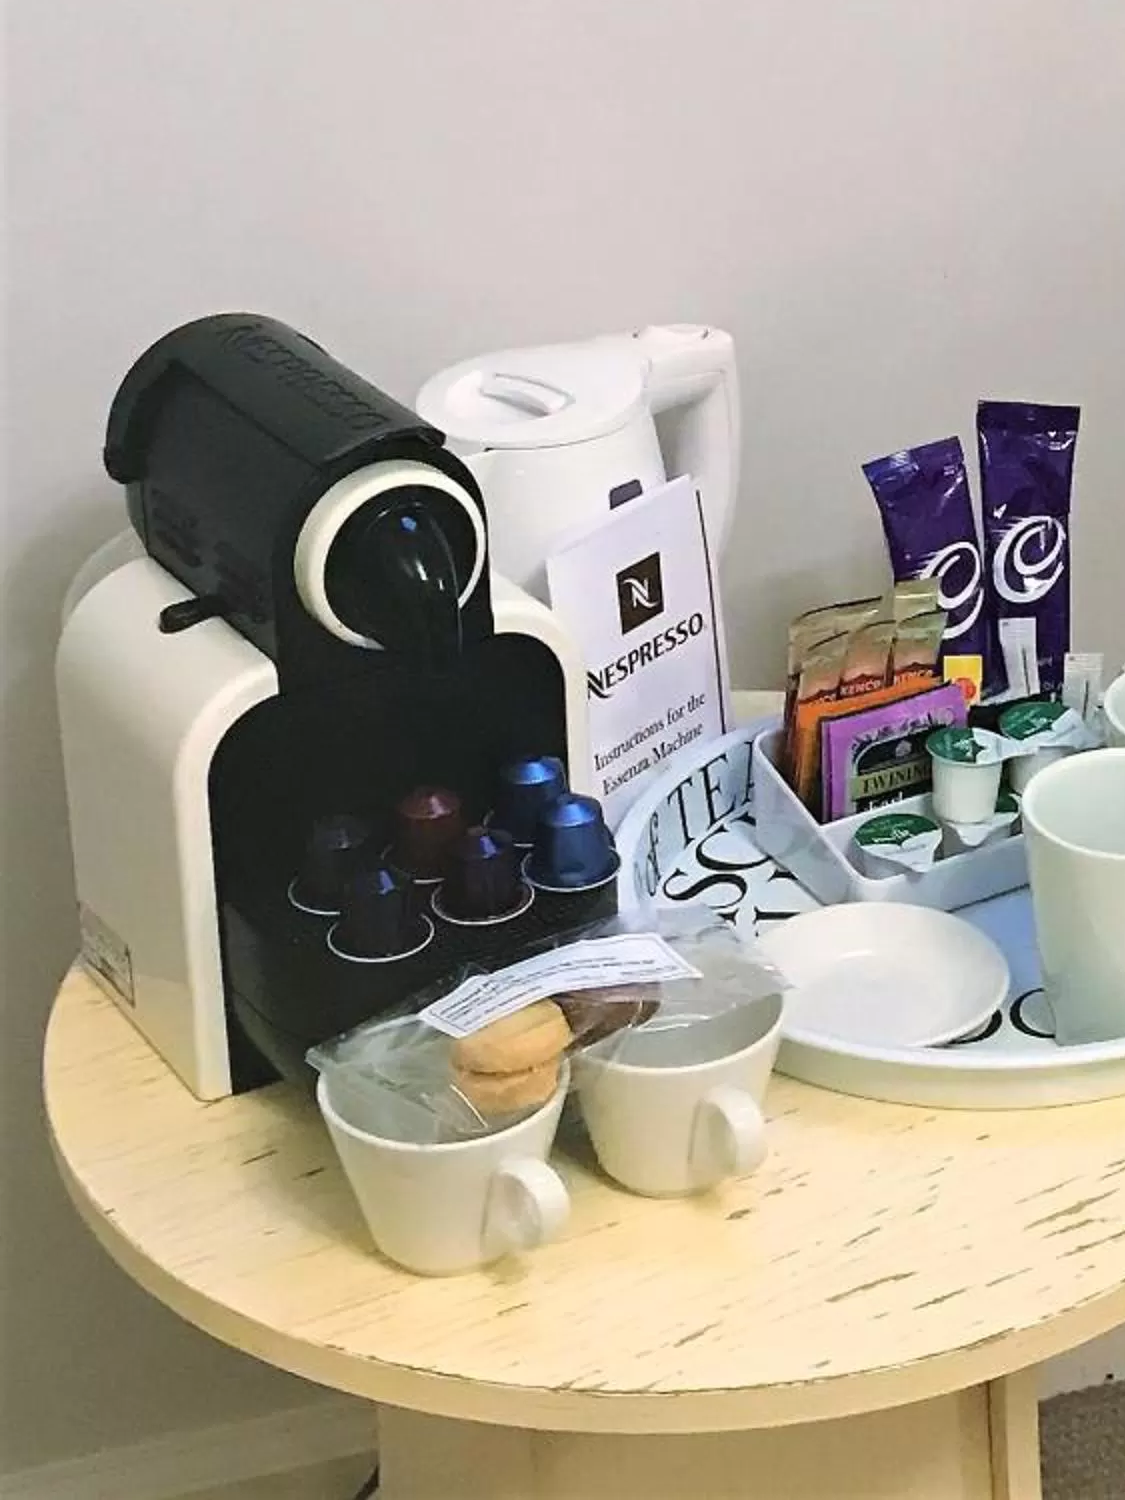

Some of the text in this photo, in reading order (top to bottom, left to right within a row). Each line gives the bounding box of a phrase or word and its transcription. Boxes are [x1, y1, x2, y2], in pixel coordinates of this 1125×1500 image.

[586, 611, 704, 700] NESPRESSO
[594, 692, 706, 772] Instructions for the
[602, 722, 703, 796] Essenza Machine
